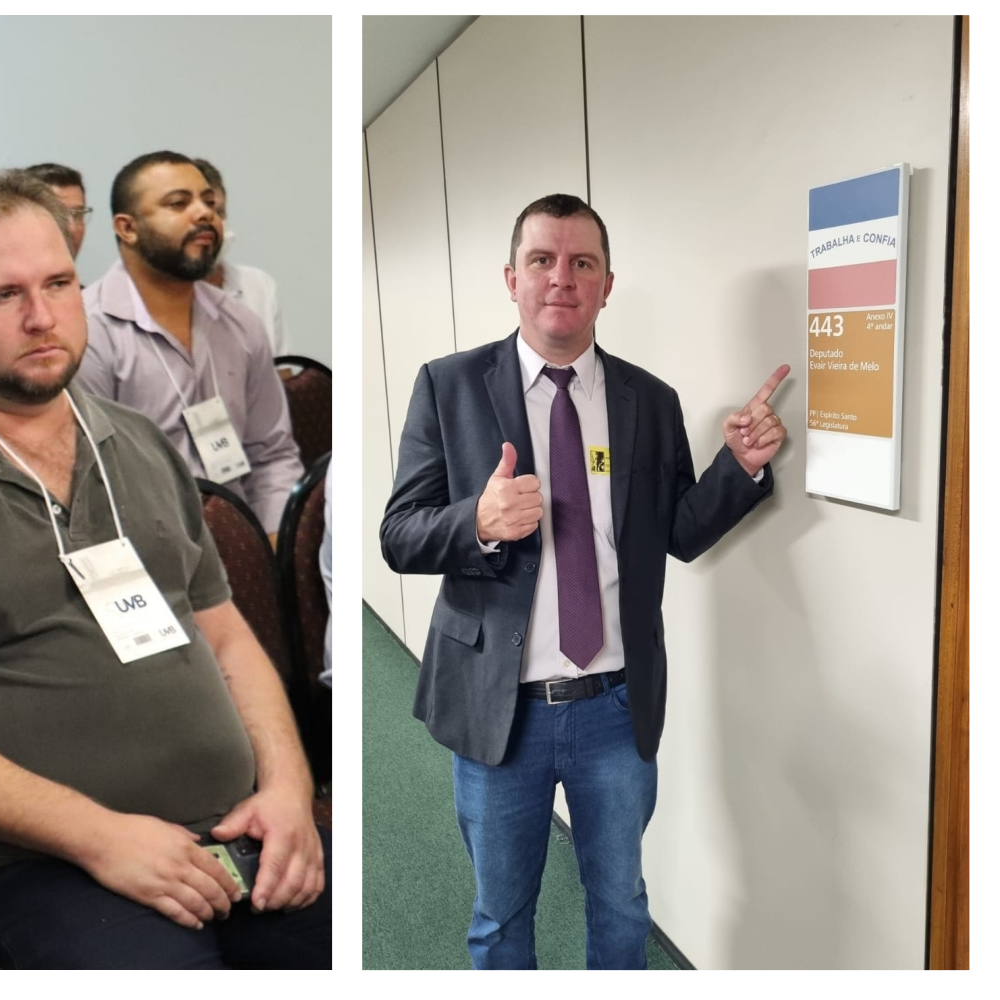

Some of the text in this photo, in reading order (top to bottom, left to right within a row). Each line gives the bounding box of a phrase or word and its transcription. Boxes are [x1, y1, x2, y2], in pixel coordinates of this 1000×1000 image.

[810, 234, 855, 259] TRABALHA
[863, 233, 896, 248] CONFIA
[866, 313, 886, 321] Anexo
[809, 315, 844, 337] 443
[875, 322, 893, 330] andar
[809, 348, 844, 360] Deputado
[809, 360, 880, 371] Evair Vieira de Melo
[114, 594, 148, 613] UVB
